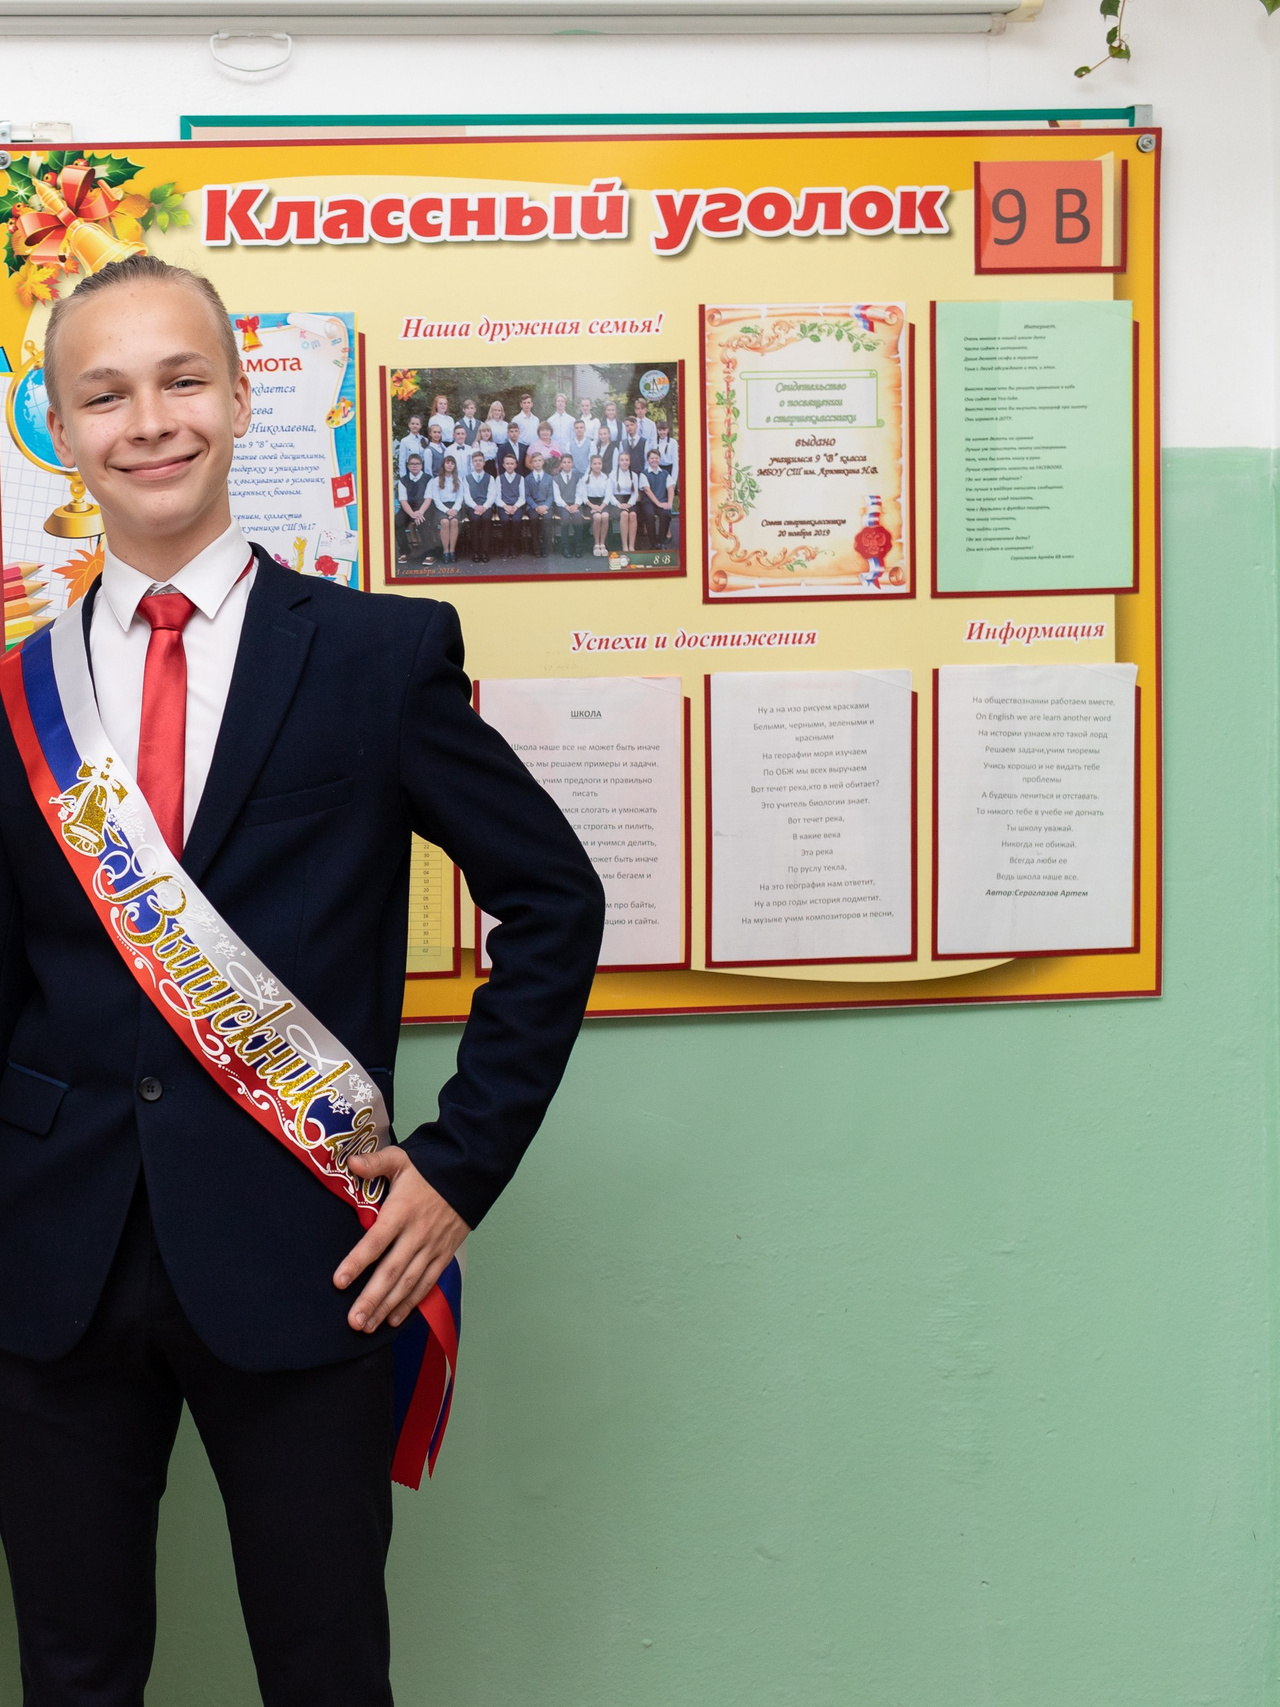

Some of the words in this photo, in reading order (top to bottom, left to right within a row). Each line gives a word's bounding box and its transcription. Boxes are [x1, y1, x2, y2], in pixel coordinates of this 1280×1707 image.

[204, 180, 626, 243] Классный
[656, 187, 947, 252] уголок
[991, 189, 1027, 246] 9
[1057, 189, 1091, 243] В
[403, 317, 472, 339] Наша
[478, 316, 580, 343] дружная
[588, 313, 664, 336] семья!
[249, 423, 316, 435] Николаевна,
[795, 435, 835, 447] выдано
[840, 455, 866, 464] класса
[966, 621, 1105, 644] Информация
[571, 631, 647, 652] Успехи
[655, 635, 667, 649] и
[675, 630, 817, 650] достижения
[758, 707, 767, 715] Ну
[803, 705, 831, 714] рисуем
[833, 703, 870, 711] красками
[989, 713, 1014, 721] English
[1063, 714, 1091, 722] another
[1093, 714, 1111, 722] word
[795, 734, 834, 742] красными
[616, 743, 635, 751] быть
[776, 768, 794, 776] ОБЖ
[829, 765, 867, 774] выручаем
[1023, 776, 1061, 784] проблемы
[777, 801, 807, 809] учитель
[809, 799, 845, 807] биологии
[583, 823, 616, 831] строгать
[754, 916, 782, 924] музыке
[784, 915, 804, 923] учим
[806, 912, 860, 922] композиторов
